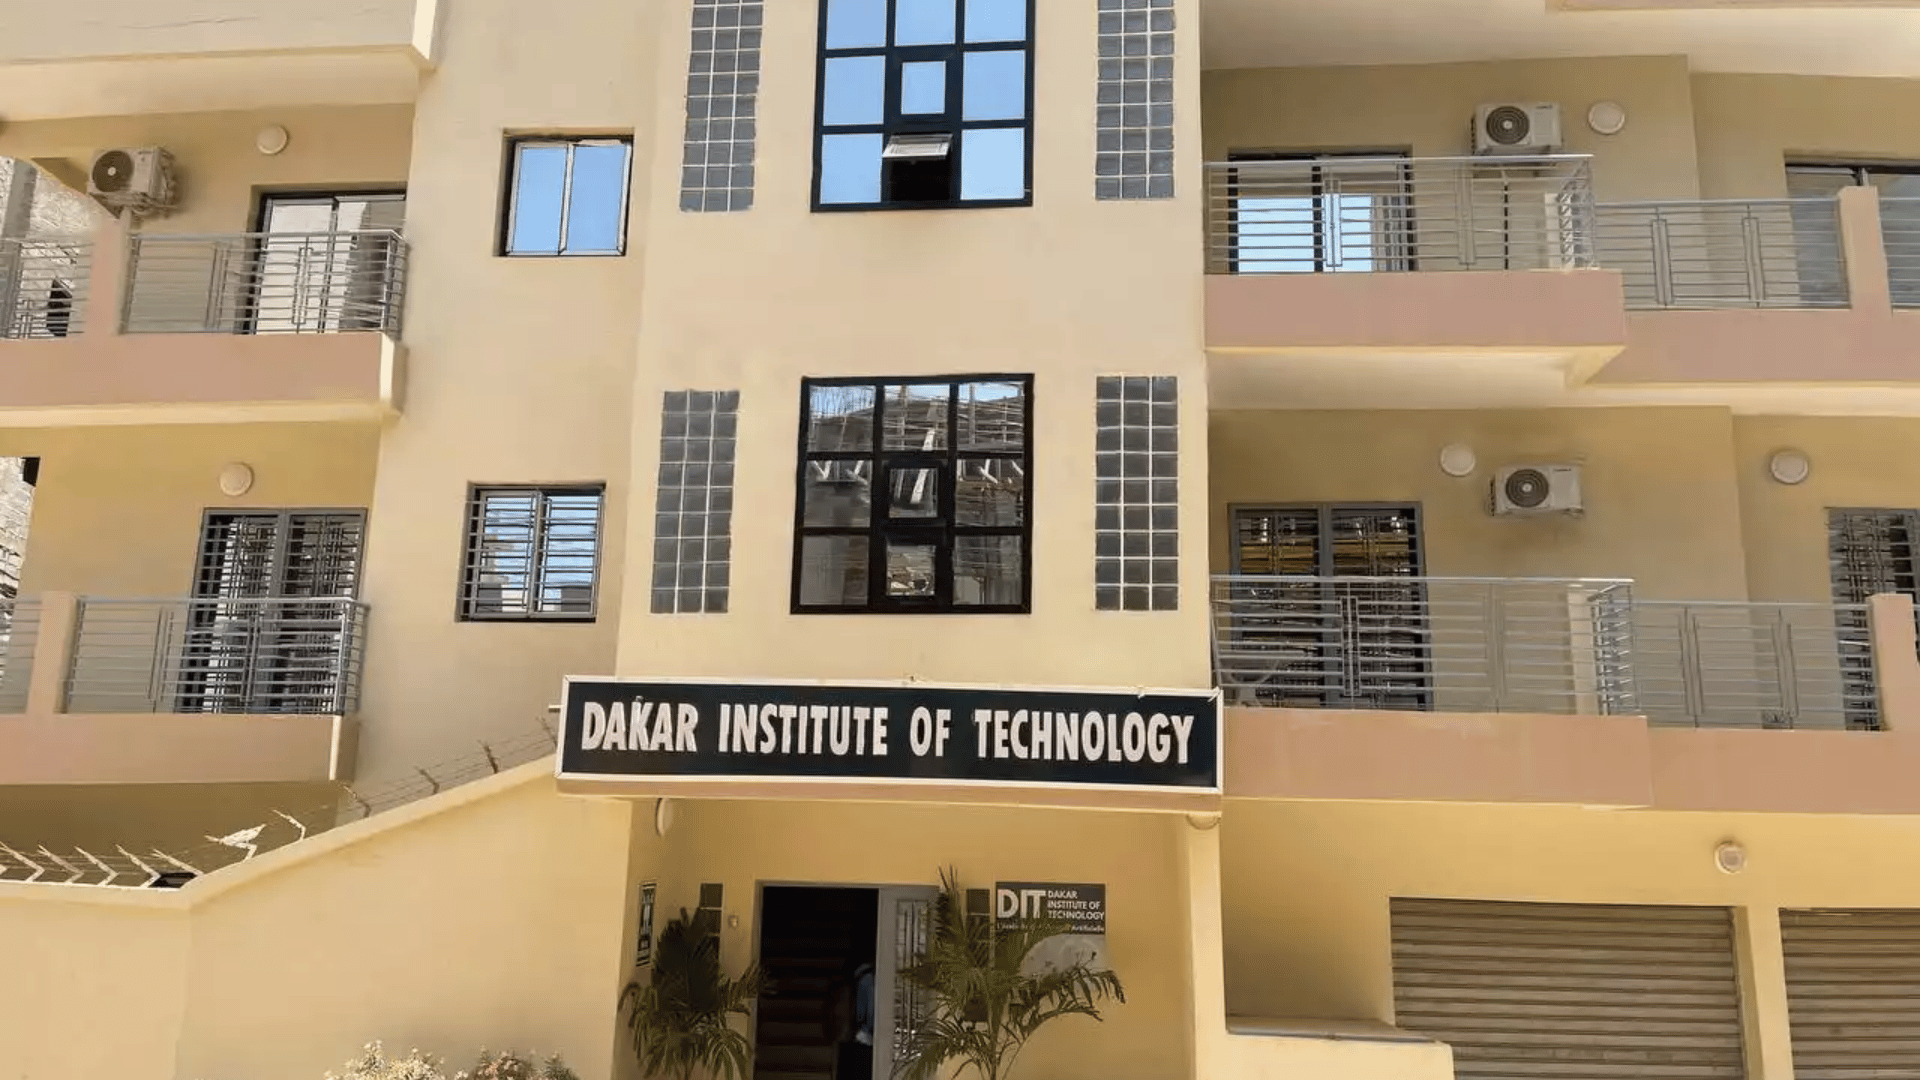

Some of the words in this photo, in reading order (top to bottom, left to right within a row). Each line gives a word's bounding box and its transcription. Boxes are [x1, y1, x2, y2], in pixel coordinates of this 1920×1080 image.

[581, 701, 699, 752] DAKAR
[718, 703, 889, 756] INSTITUTE
[909, 706, 951, 757] OF
[974, 708, 1195, 764] TECHNOLOGY
[1047, 890, 1078, 899] DAKAR
[997, 889, 1046, 919] DIT
[1047, 900, 1088, 910] INSTITUTE
[1088, 901, 1101, 910] OF
[1047, 910, 1104, 920] TECHNOLOGY
